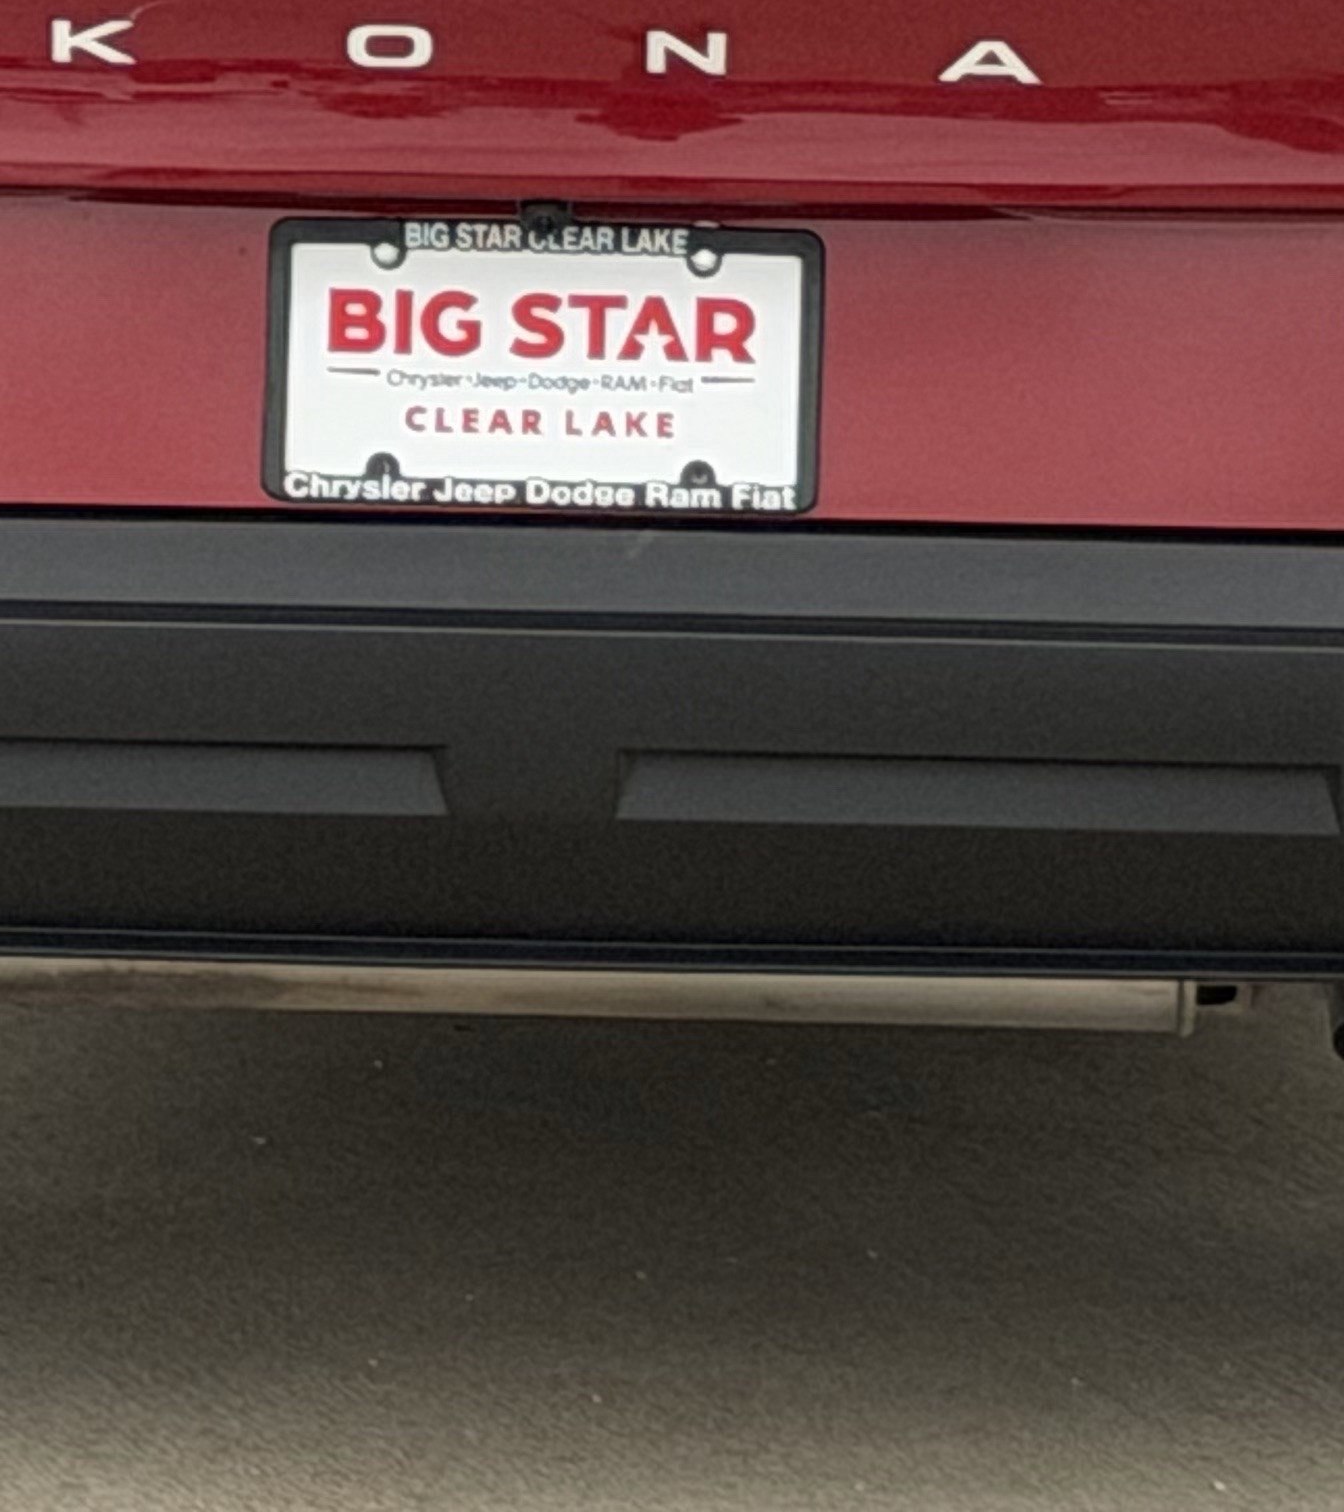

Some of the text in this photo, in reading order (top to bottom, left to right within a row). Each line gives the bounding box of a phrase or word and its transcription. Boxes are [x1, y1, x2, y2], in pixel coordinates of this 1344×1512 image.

[405, 222, 449, 248] BIG
[456, 223, 522, 249] STAR
[621, 228, 689, 255] LAKE
[327, 288, 756, 364] BIG STAR
[405, 406, 674, 438] CLEAR LAKE
[284, 472, 796, 510] Chrysler Jeep Dodge Ram Fiat
